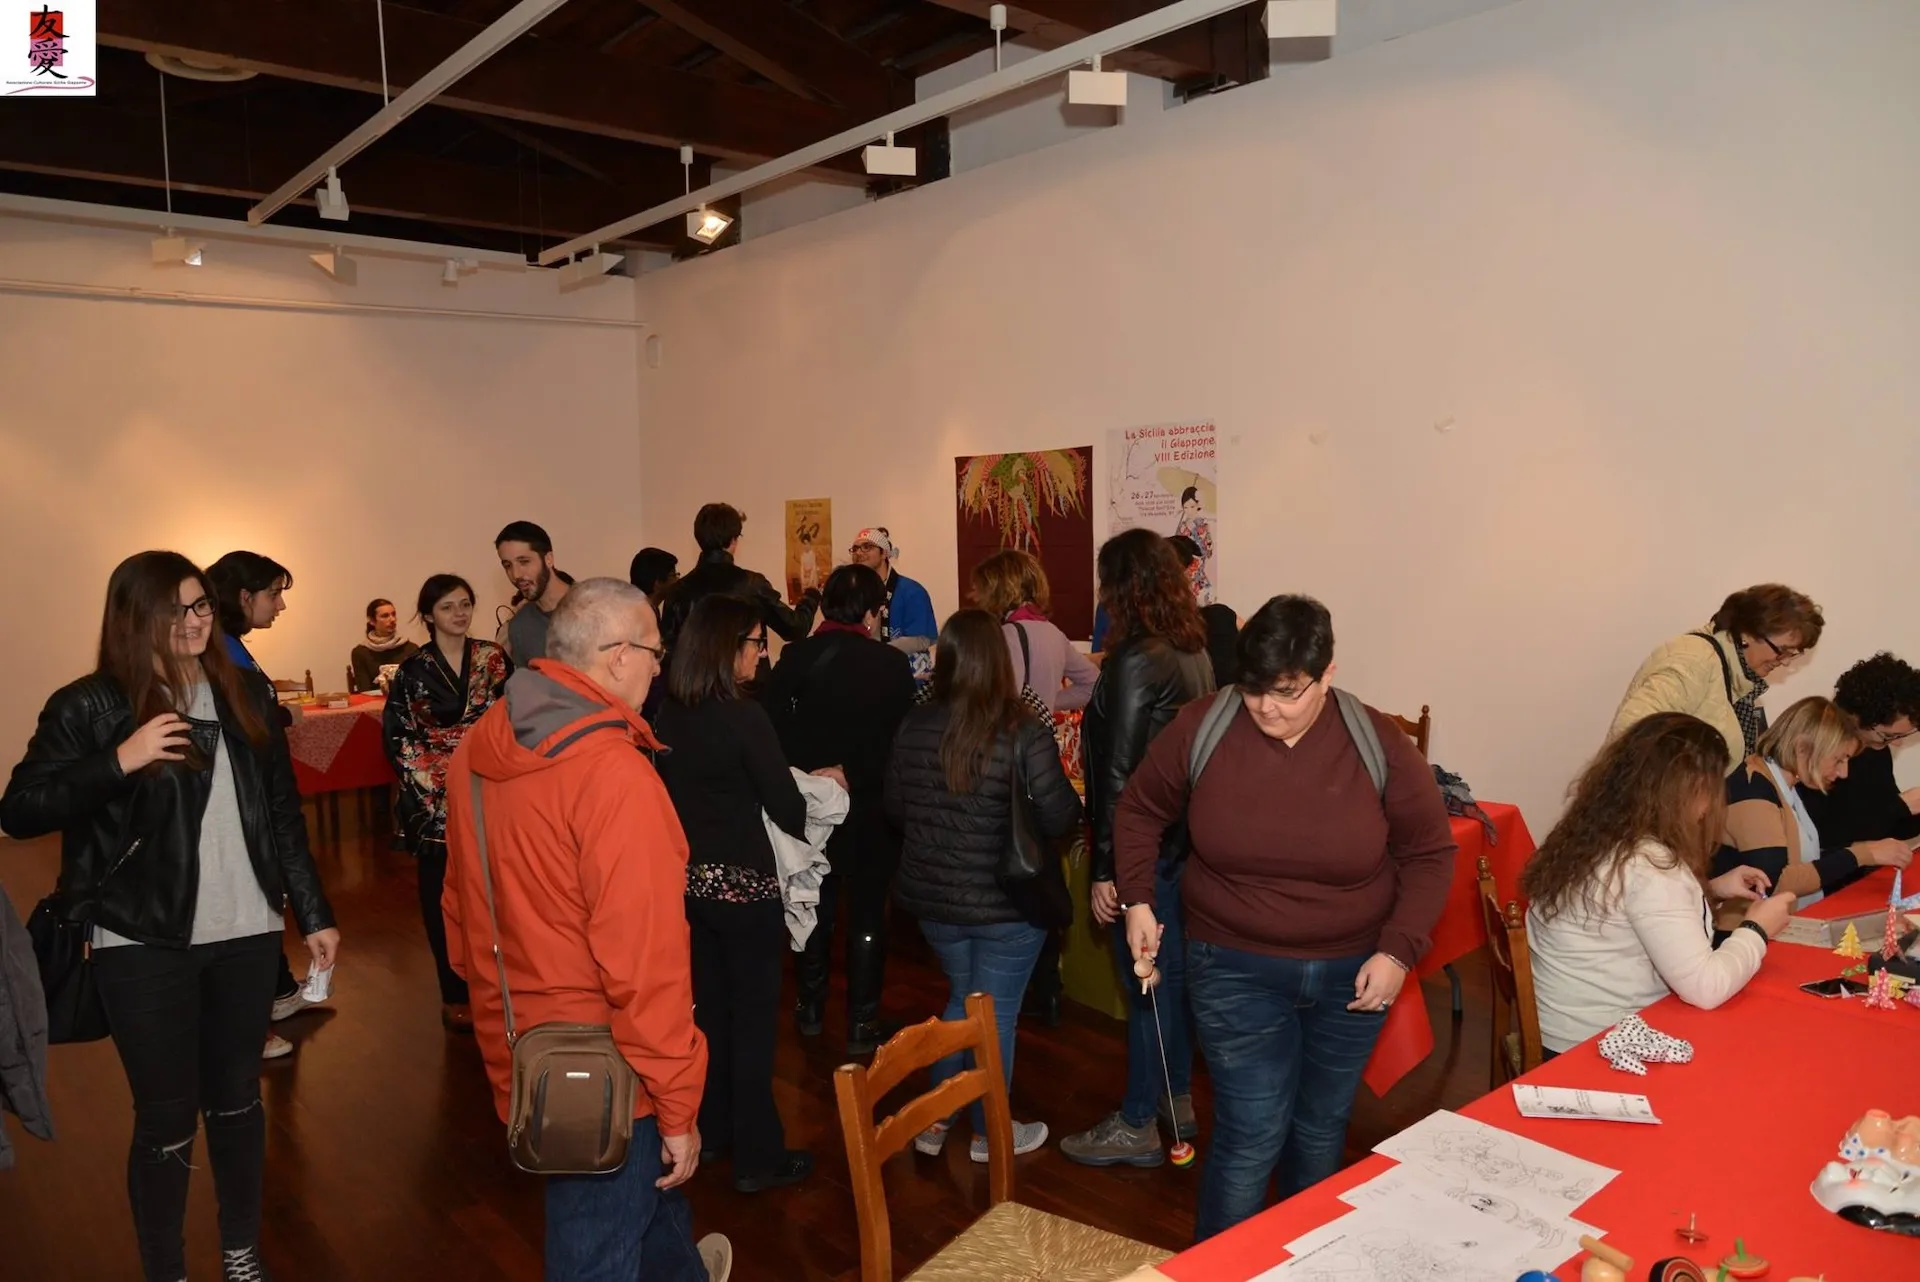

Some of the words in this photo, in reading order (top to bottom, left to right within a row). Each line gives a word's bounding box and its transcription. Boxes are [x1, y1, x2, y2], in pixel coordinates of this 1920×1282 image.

[1125, 429, 1136, 440] La
[1139, 427, 1166, 439] Sicilia
[1168, 423, 1215, 436] abbraccia
[1170, 436, 1215, 449] Giappone
[1154, 452, 1171, 462] VIII
[1173, 449, 1215, 461] Edizione
